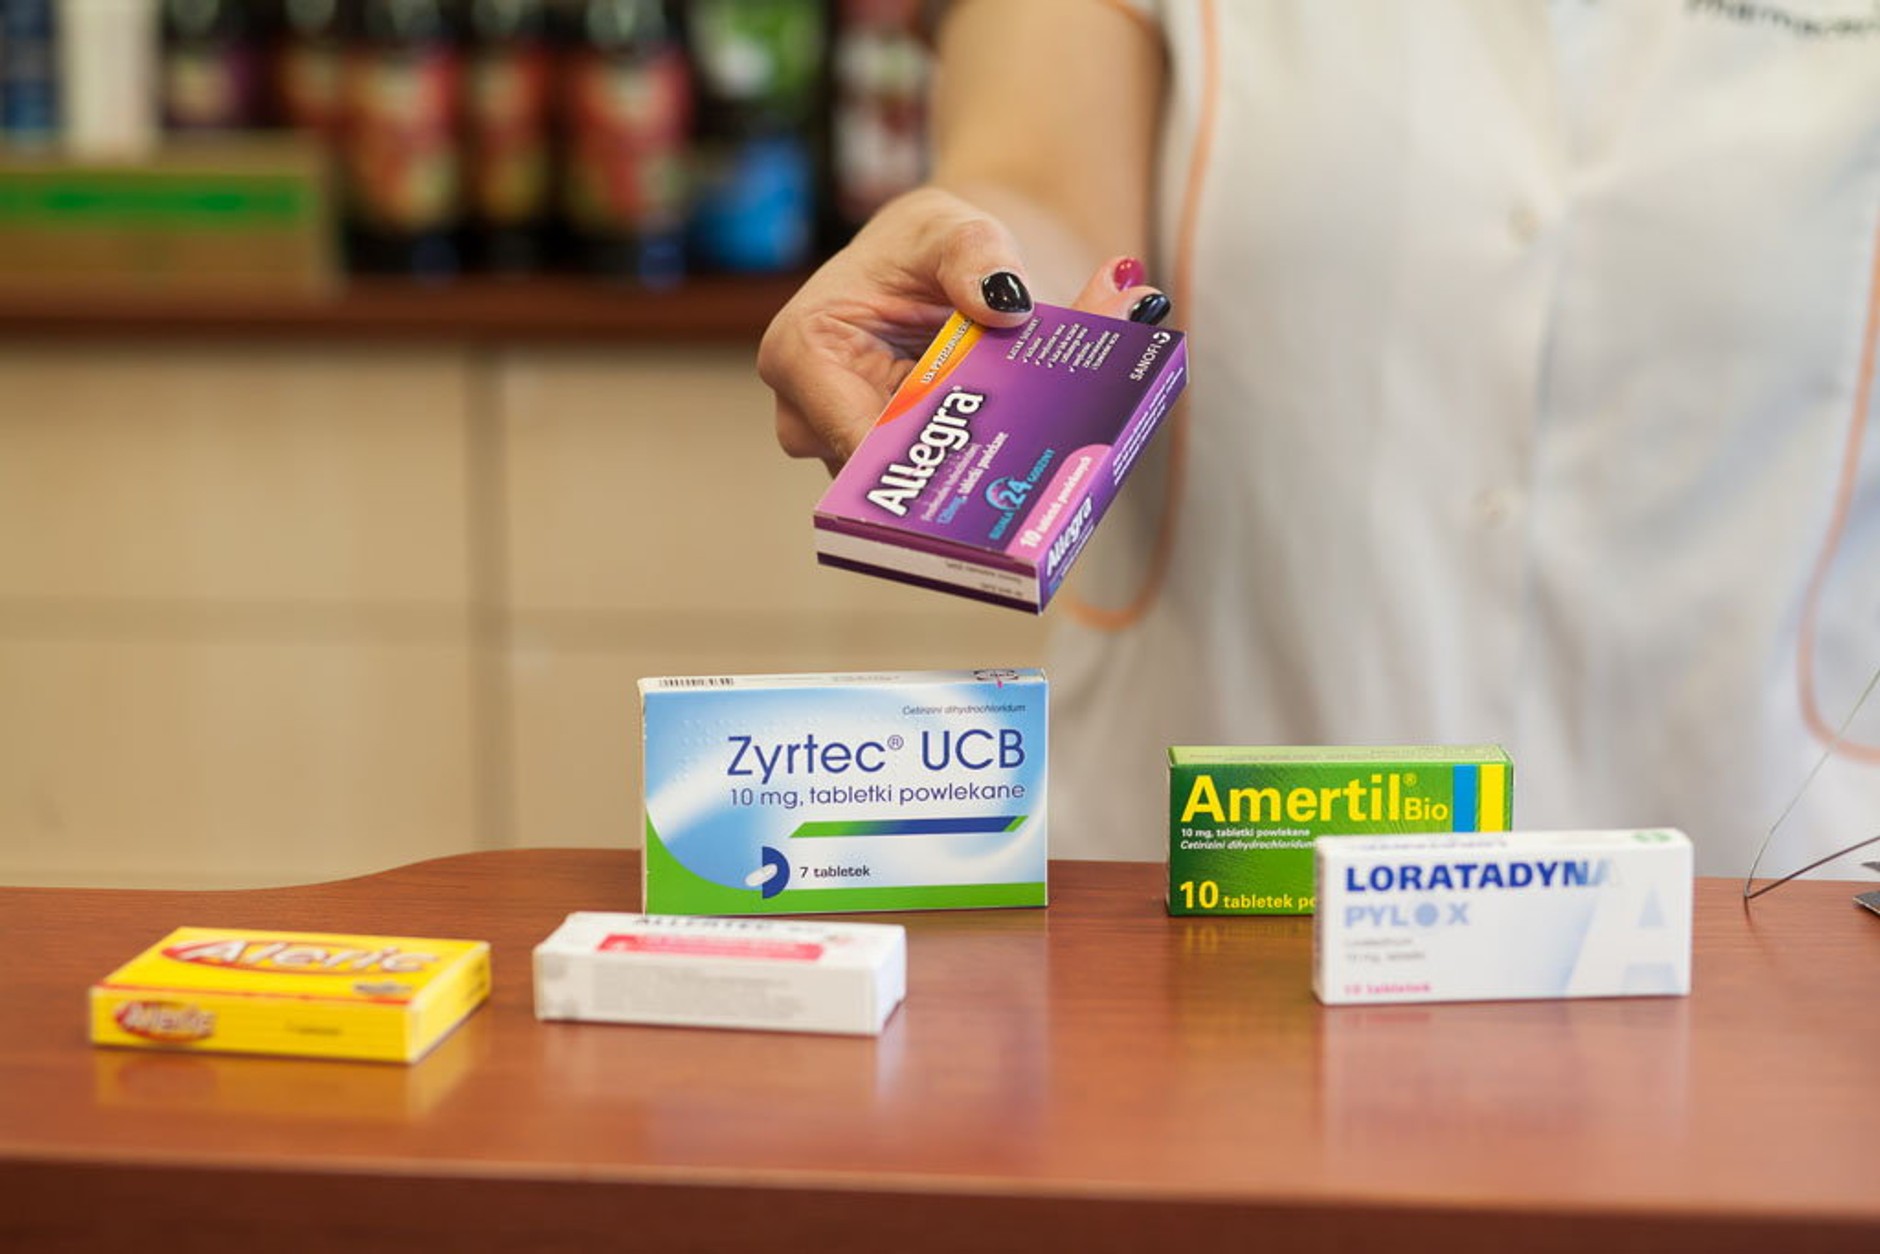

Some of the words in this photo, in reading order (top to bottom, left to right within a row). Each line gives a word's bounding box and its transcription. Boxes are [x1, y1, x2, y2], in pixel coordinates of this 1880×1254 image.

[1128, 343, 1164, 380] SANOFI
[866, 392, 984, 516] Allegra
[995, 478, 1035, 504] 24
[1017, 530, 1044, 547] 10
[921, 729, 1026, 772] UCB
[731, 788, 754, 806] 10
[760, 789, 804, 809] mg,
[809, 784, 893, 804] tabletki
[899, 782, 1026, 806] powlekane
[1404, 797, 1449, 821] Bio
[1180, 840, 1226, 850] Cetirizini
[1181, 828, 1193, 837] 10
[1216, 828, 1254, 837] tabletki
[1256, 828, 1310, 838] powlekane
[800, 866, 808, 878] 7
[813, 865, 871, 878] tabletek
[1179, 881, 1219, 909] 10
[1224, 894, 1293, 909] tabletek
